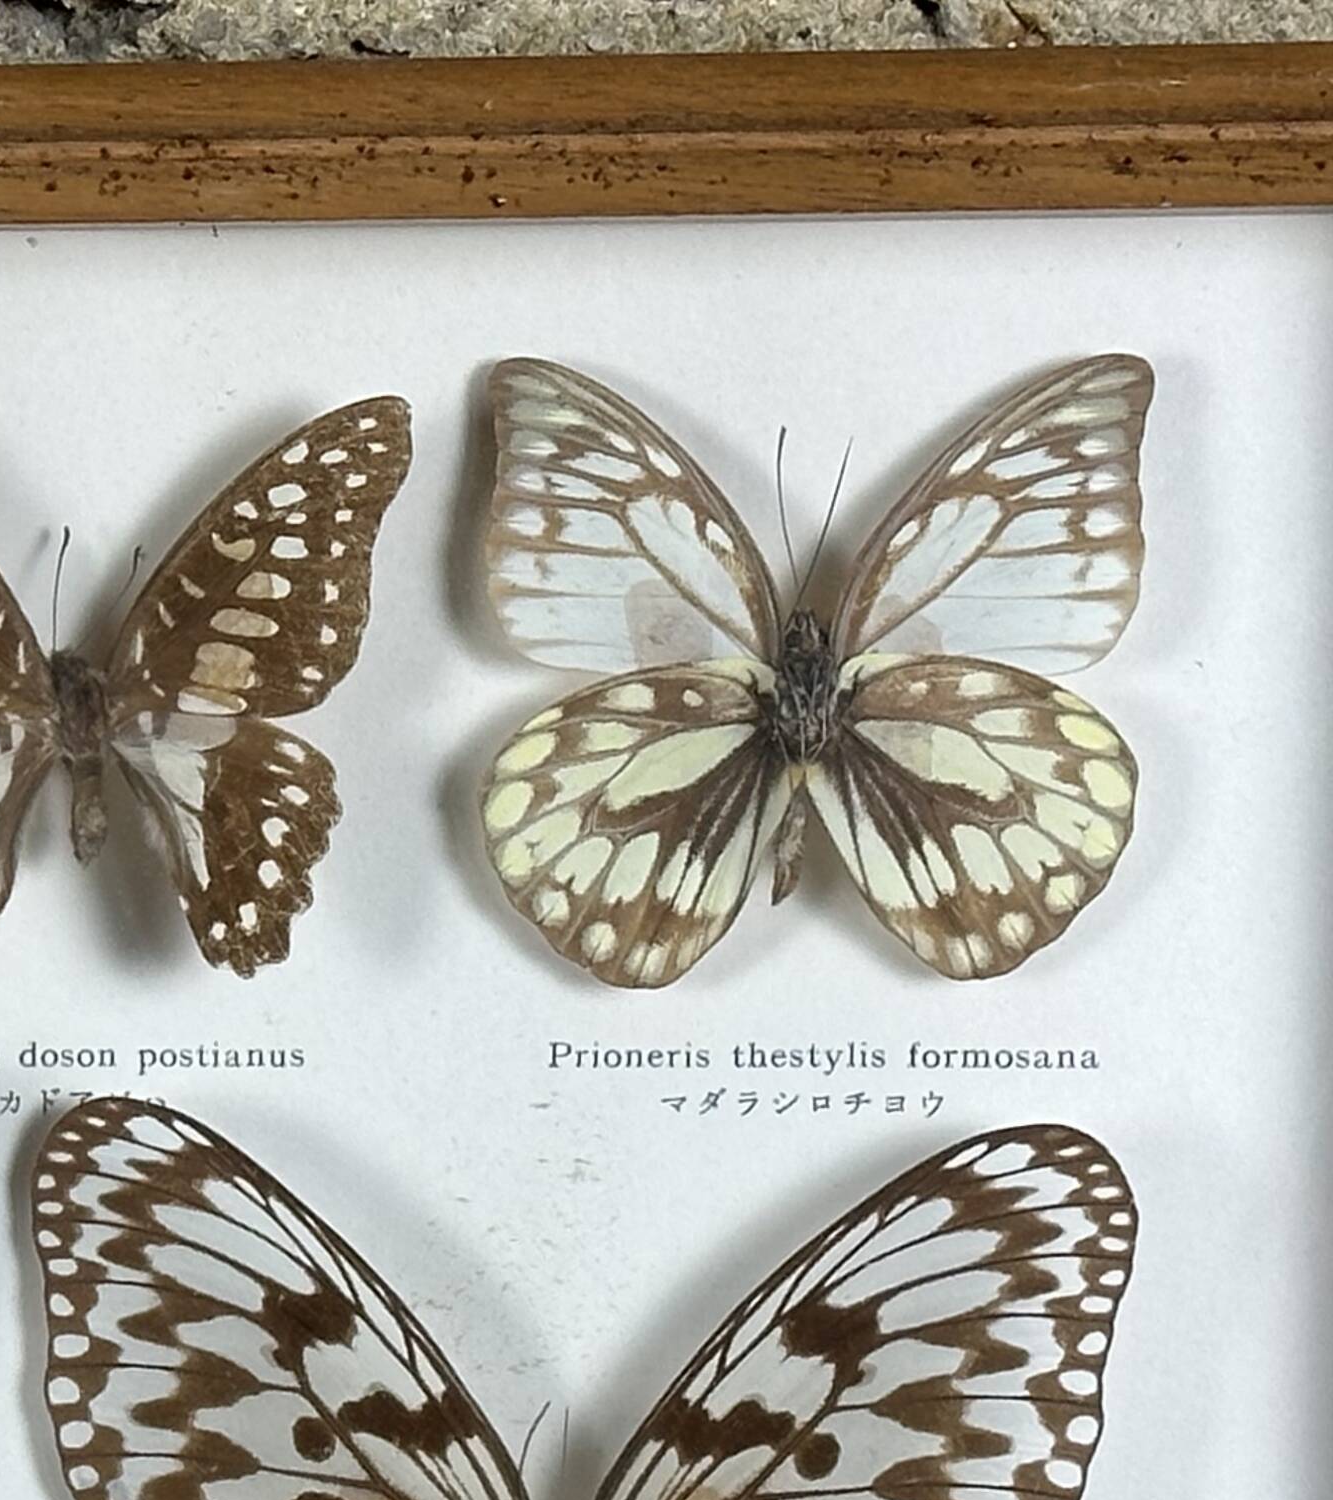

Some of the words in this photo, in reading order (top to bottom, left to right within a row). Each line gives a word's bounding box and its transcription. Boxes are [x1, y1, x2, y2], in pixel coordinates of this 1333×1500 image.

[18, 1040, 118, 1069] doson
[137, 1039, 306, 1077] postianus
[547, 1040, 711, 1070] Prioneris
[732, 1040, 887, 1077] thestylis
[906, 1040, 1101, 1070] formosana
